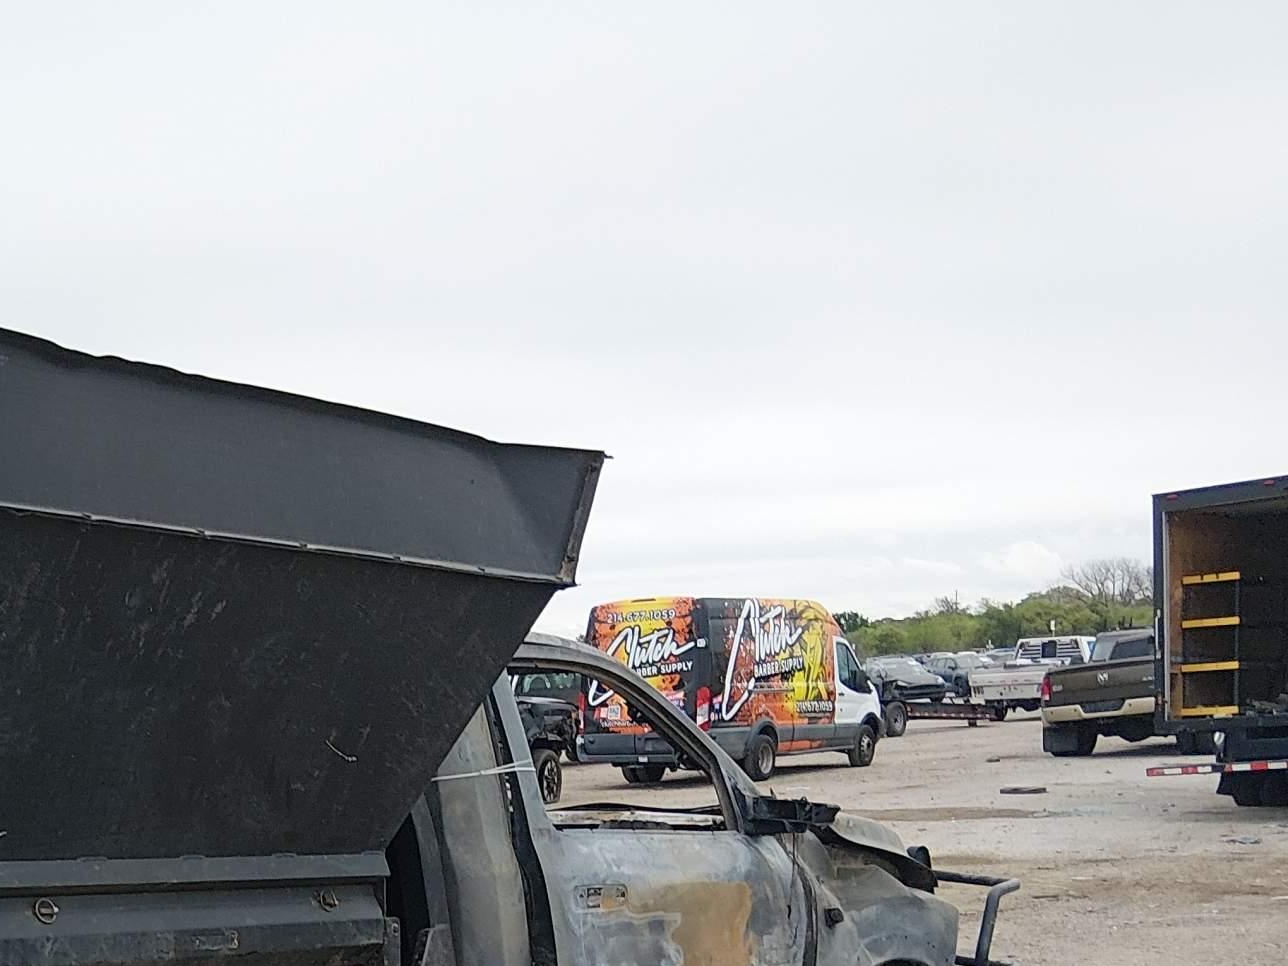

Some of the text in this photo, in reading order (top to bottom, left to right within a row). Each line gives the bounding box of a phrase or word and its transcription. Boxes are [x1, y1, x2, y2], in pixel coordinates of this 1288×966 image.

[661, 661, 694, 674] SUPPLY
[722, 597, 803, 721] Clutch
[754, 655, 804, 678] BARBER SUPPLY
